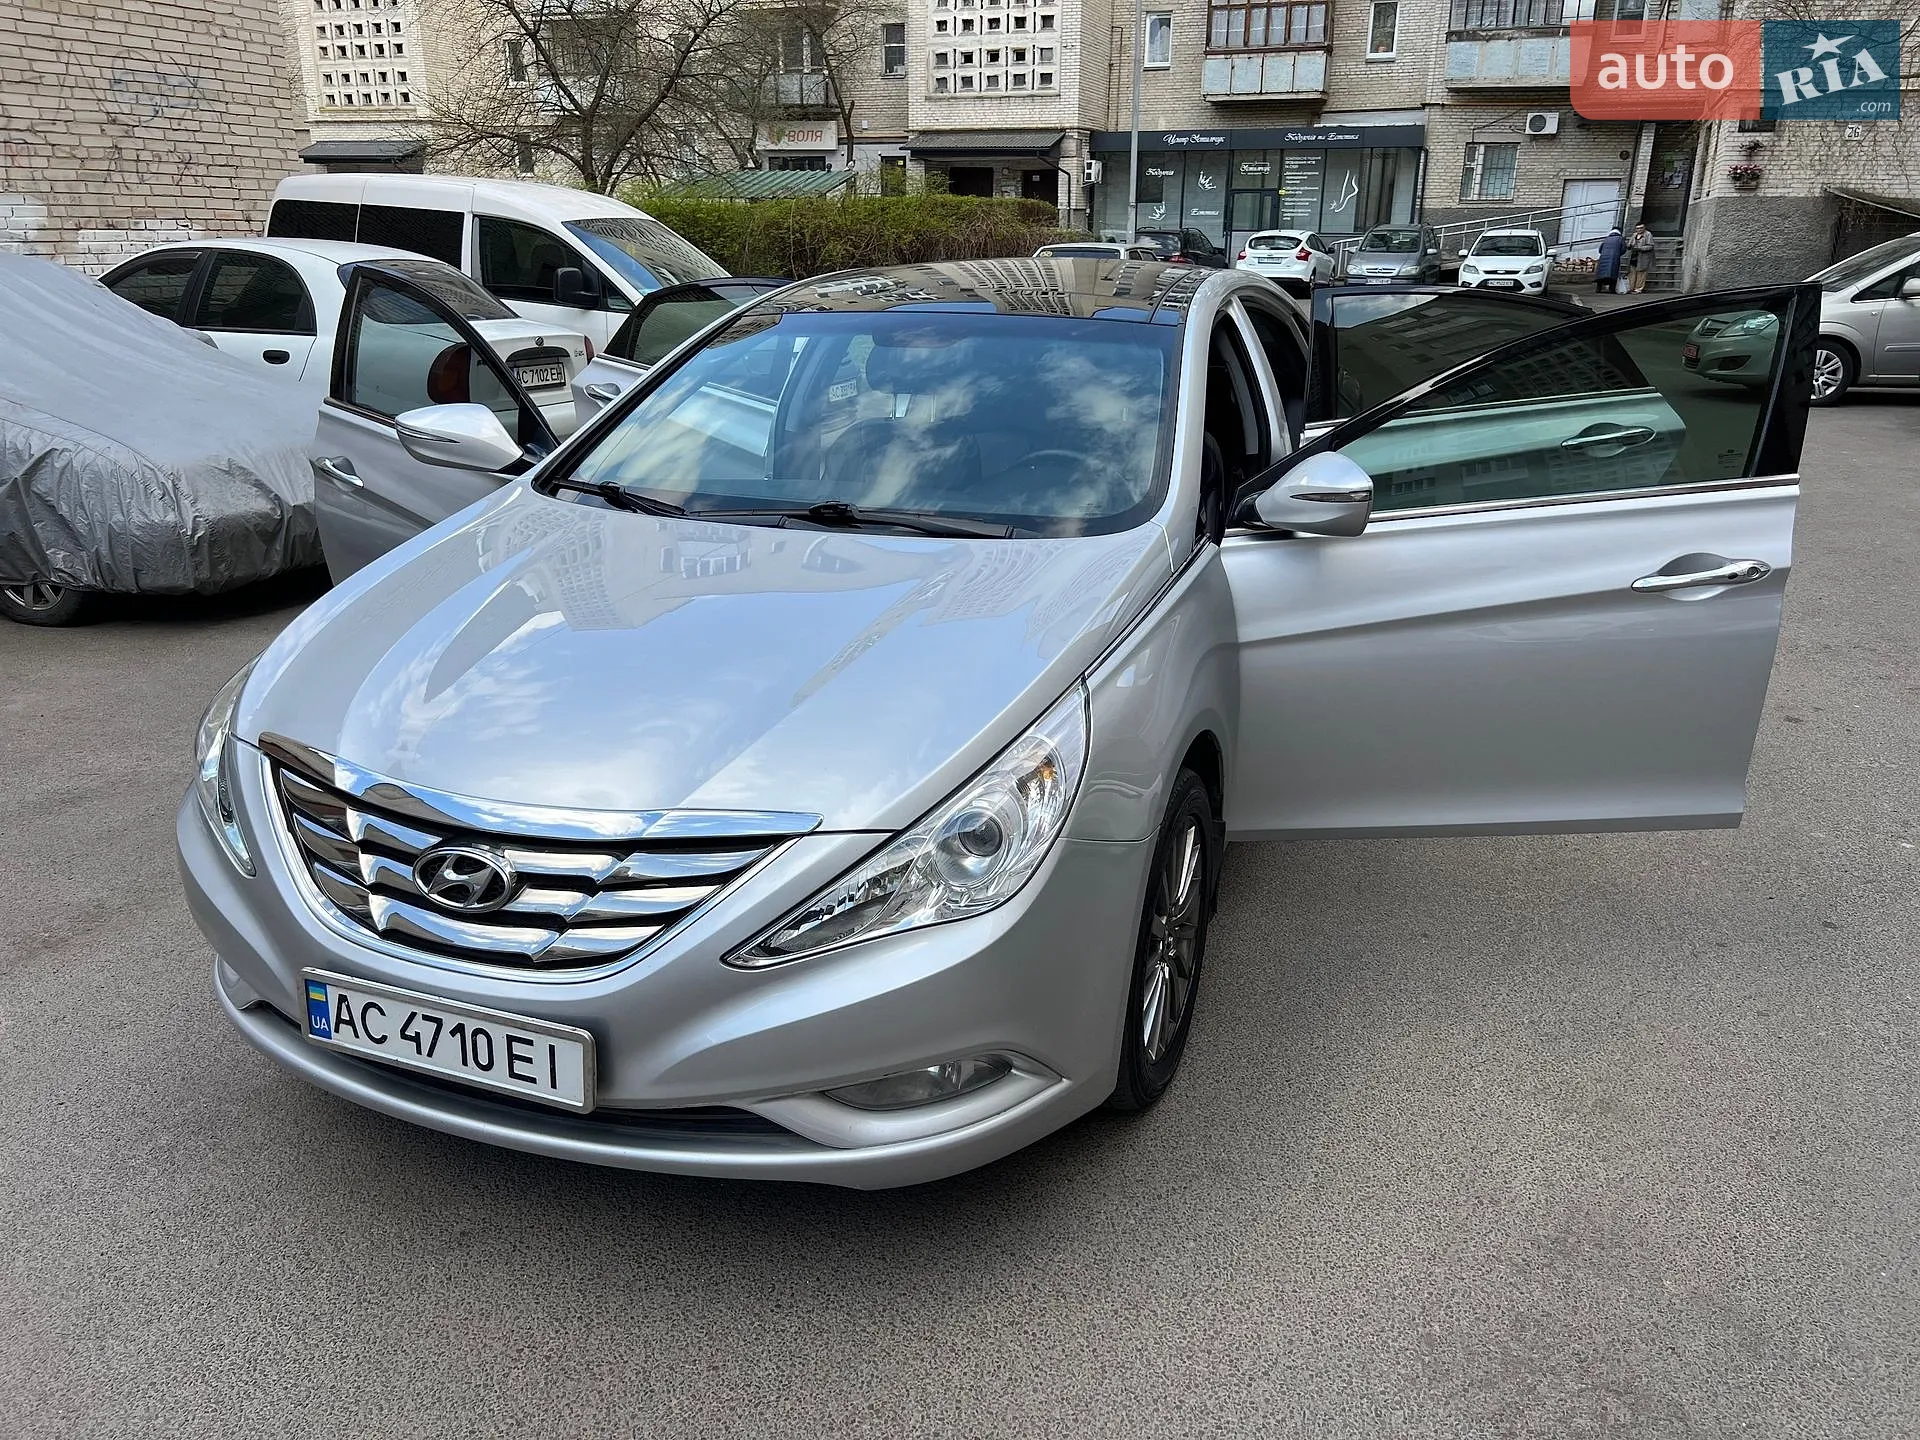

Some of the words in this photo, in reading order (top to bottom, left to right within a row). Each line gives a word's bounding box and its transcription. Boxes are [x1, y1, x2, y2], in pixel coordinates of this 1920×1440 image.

[787, 129, 823, 143] ВОЛЯ
[529, 368, 550, 383] 7102
[311, 1014, 329, 1032] UA
[333, 993, 389, 1045] AC
[399, 1010, 495, 1072] 4710
[505, 1032, 558, 1090] EI
